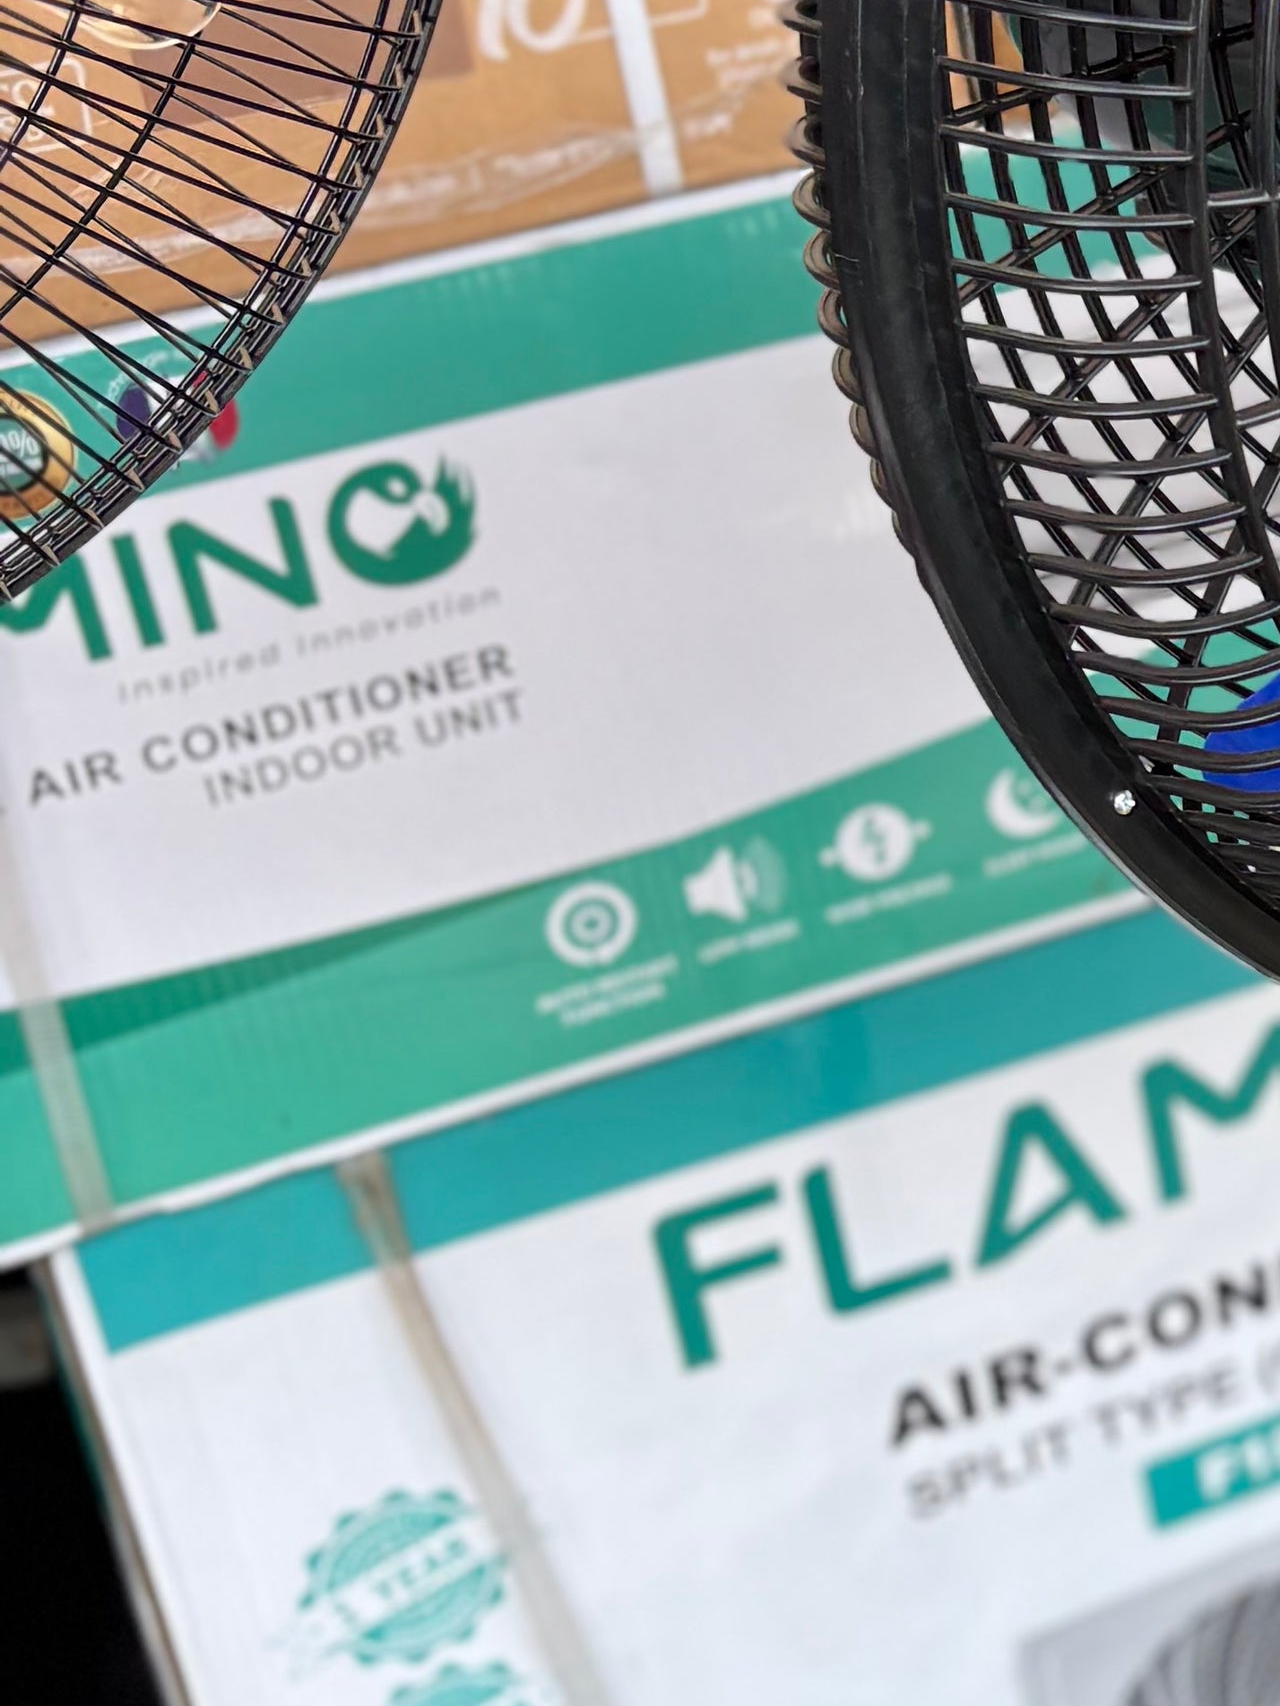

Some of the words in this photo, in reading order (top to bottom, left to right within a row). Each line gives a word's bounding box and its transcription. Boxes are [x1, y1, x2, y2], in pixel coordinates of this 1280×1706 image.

[27, 748, 124, 809] AIR
[140, 642, 514, 776] CONDITIONER
[201, 724, 404, 811] INDOOR
[413, 684, 526, 750] UNIT
[908, 1421, 1074, 1522] SPLIT
[1096, 1355, 1242, 1446] TYPE
